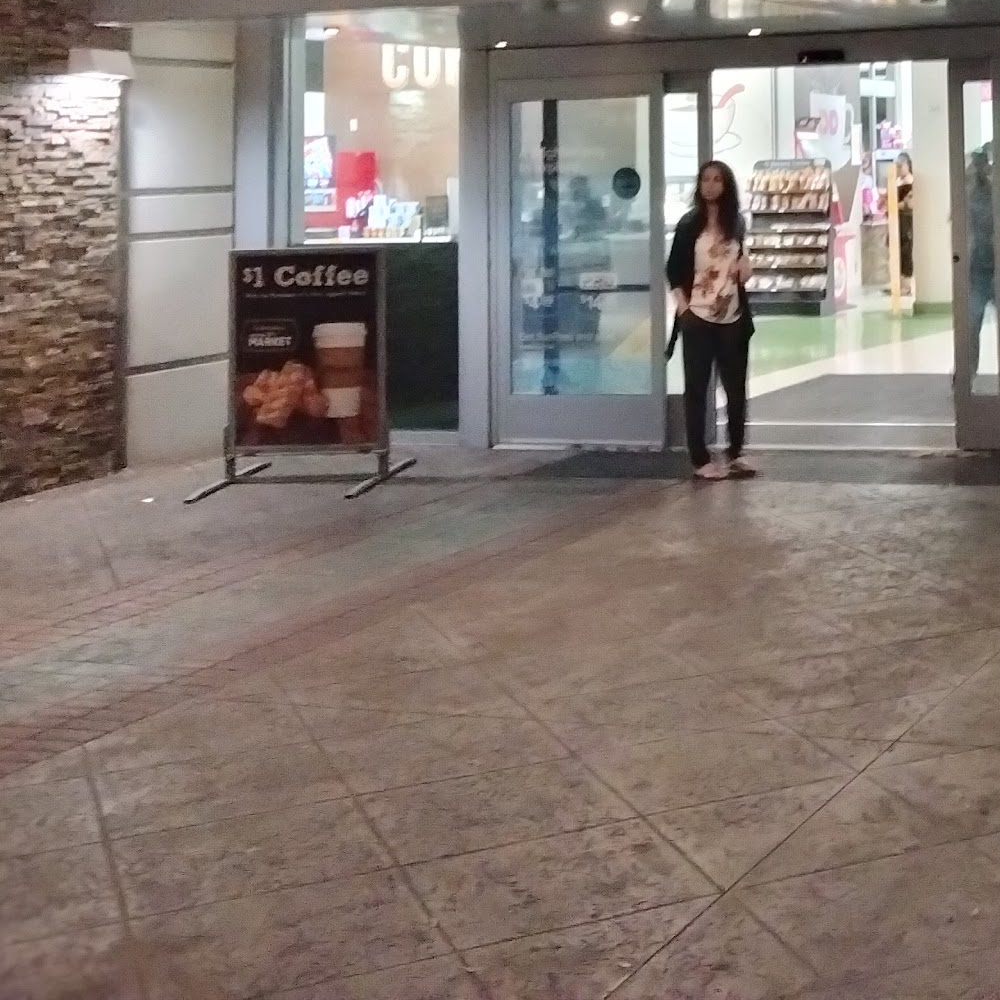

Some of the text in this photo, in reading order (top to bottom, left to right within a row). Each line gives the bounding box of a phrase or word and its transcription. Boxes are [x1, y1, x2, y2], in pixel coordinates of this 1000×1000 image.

[242, 264, 369, 288] $1 Coffee
[247, 335, 292, 347] MARKET
